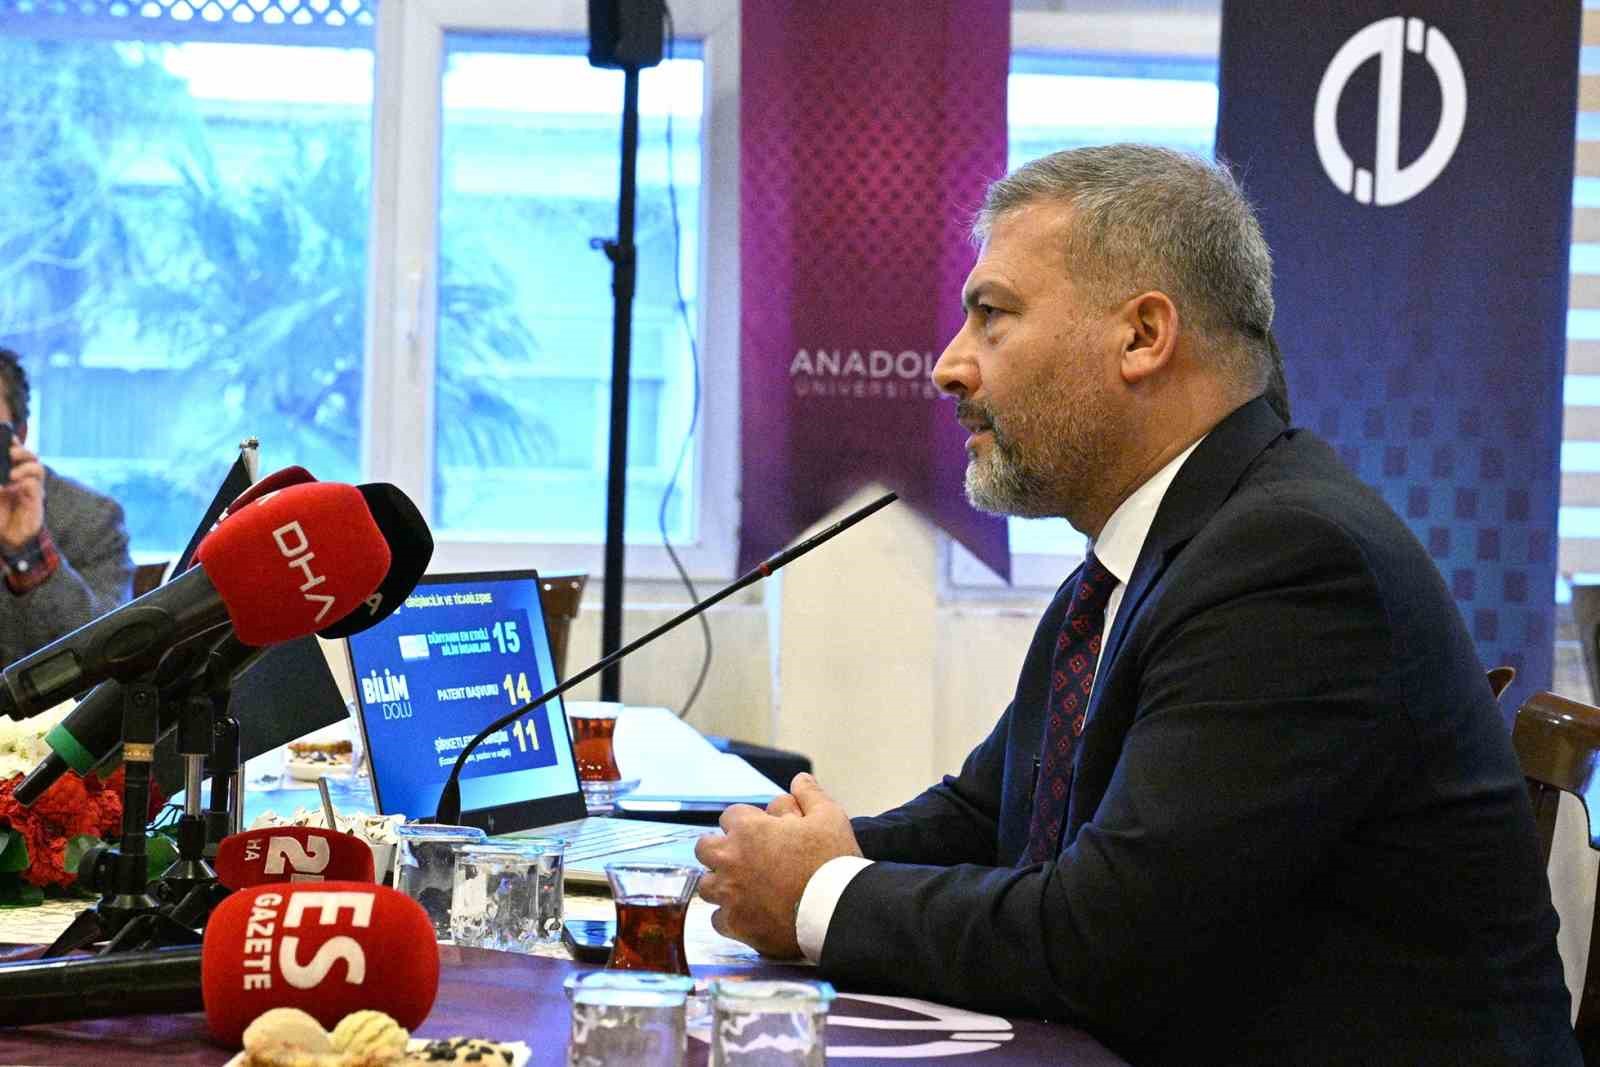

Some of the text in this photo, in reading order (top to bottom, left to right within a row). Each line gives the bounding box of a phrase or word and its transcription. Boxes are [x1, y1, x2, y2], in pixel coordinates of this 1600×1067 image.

[790, 349, 933, 378] ANADOL
[272, 520, 336, 623] DHA
[492, 621, 521, 654] 15
[361, 667, 410, 704] BİLİM
[503, 672, 531, 706] 14
[383, 702, 412, 720] DOLU
[513, 719, 540, 752] 11
[264, 834, 331, 883] 2
[243, 893, 283, 990] GAZETE
[279, 891, 375, 989] ES
